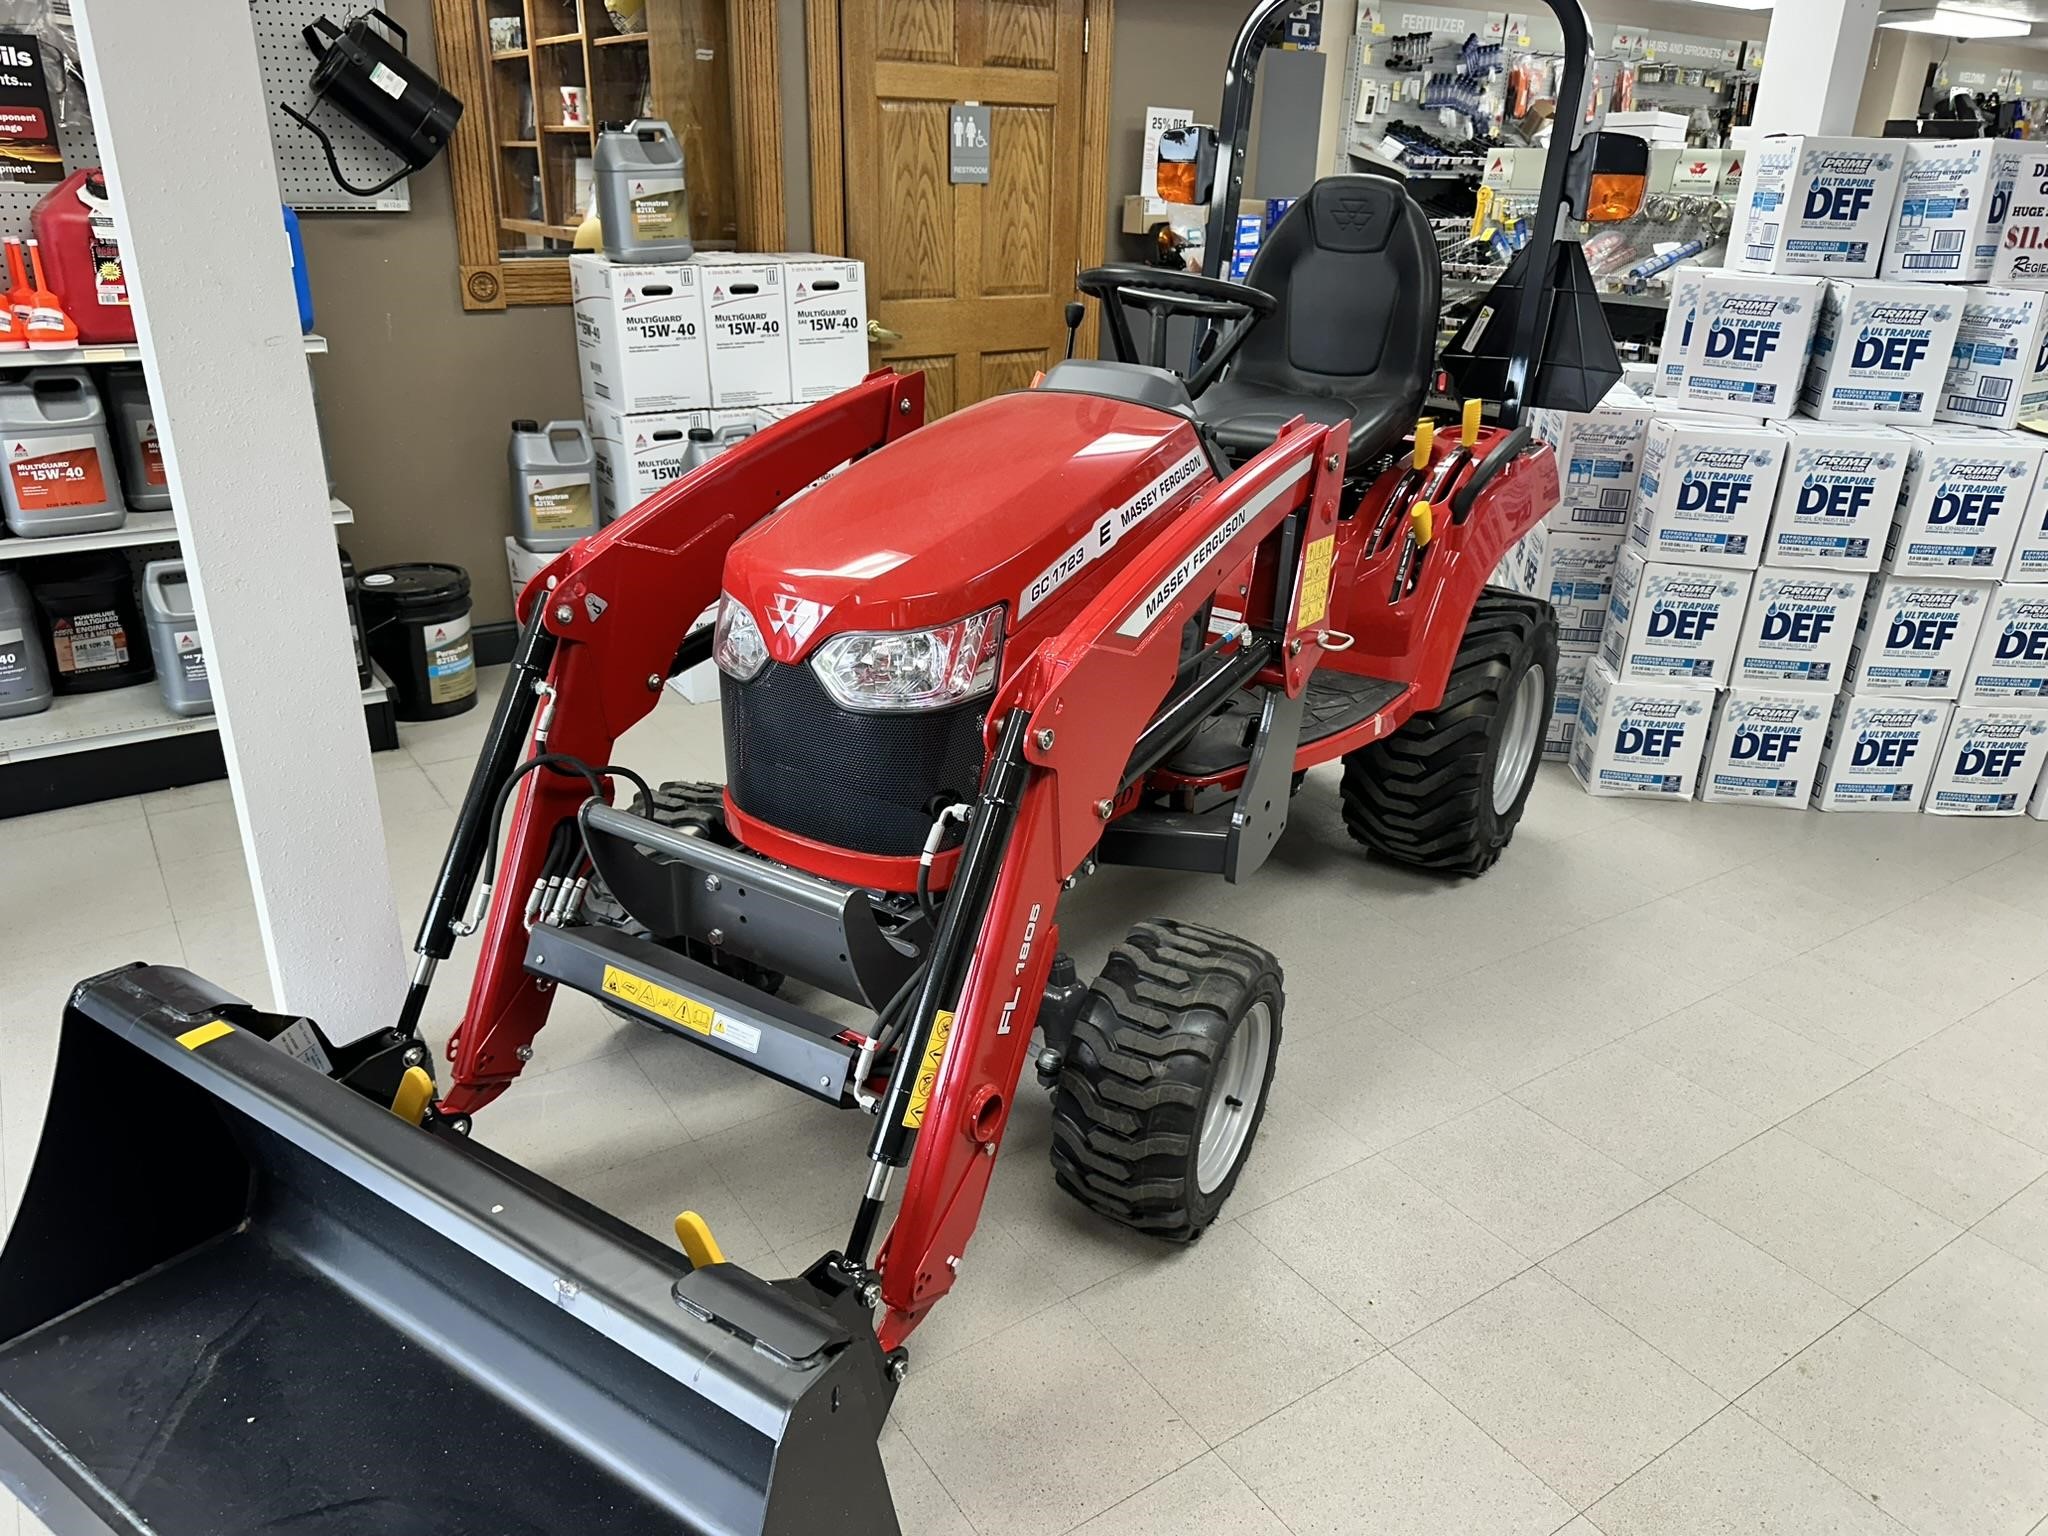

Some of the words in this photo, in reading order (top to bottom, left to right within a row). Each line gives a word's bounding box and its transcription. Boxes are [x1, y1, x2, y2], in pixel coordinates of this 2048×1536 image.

[1401, 13, 1465, 34] FERTILIZER
[1649, 39, 1668, 52] HUBS
[1669, 42, 1684, 54] AND
[1684, 44, 1722, 59] SPROCKETS
[0, 45, 33, 67] ils
[1151, 117, 1171, 130] 25%
[1824, 159, 1871, 167] PRIME
[953, 166, 988, 174] RESTROOM
[1821, 177, 1875, 187] ULTRAPURE
[1803, 189, 1873, 220] DEF
[2012, 206, 2045, 217] HUGE
[2010, 255, 2048, 273] REGIE
[1725, 301, 1777, 310] PRIME
[1874, 310, 1927, 318] PRIME
[727, 320, 779, 336] 15W-40
[809, 316, 858, 331] 15W-40
[1722, 318, 1782, 330] ULTRAPURE
[640, 323, 696, 338] 15W-40
[1870, 327, 1932, 338] ULTRAPURE
[1705, 328, 1780, 362] DEF
[1851, 338, 1929, 370] DEF
[637, 458, 681, 469] MULTIGUA
[1697, 454, 1748, 463] PRIME
[1710, 461, 1743, 469] GUARD
[1818, 458, 1871, 466] PRIME
[30, 467, 84, 481] 15W-40
[651, 467, 680, 480] 15W
[1694, 471, 1753, 482] ULTRAPURE
[1952, 466, 2004, 474] PRIME
[1815, 475, 1876, 485] ULTRAPURE
[1120, 490, 1158, 528] MASSEY
[1160, 456, 1202, 496] FERGUSON
[1948, 484, 2007, 494] ULTRAPURE
[1676, 481, 1751, 514] DEF
[1796, 485, 1874, 517] DEF
[1928, 495, 2004, 526] DEF
[1099, 519, 1111, 548] E
[1145, 566, 1190, 619] MASSEY
[1193, 509, 1247, 569] FERGUSON
[1031, 577, 1050, 602] GC
[1051, 548, 1085, 584] 1723
[1667, 584, 1716, 593] PRIME
[1781, 587, 1832, 595] PRIME
[1664, 600, 1720, 611] ULTRAPURE
[1778, 603, 1836, 613] ULTRAPURE
[1904, 611, 1960, 620] ULTRAPURE
[1647, 610, 1718, 640] DEF
[1761, 613, 1834, 643] DEF
[2016, 621, 2048, 632] ULTRA
[1885, 621, 1958, 650] DEF
[1995, 630, 2048, 660] DE
[1632, 704, 1680, 712] PRIME
[1750, 709, 1798, 717] PRIME
[1630, 719, 1685, 729] ULTRAPURE
[1747, 724, 1803, 734] ULTRAPURE
[1977, 725, 2025, 733] PRIME
[1615, 728, 1684, 757] DEF
[1730, 733, 1801, 762] DEF
[1973, 741, 2028, 749] ULTRAPURE
[1851, 740, 1919, 766] DEF
[1955, 750, 2026, 776] DEF
[997, 986, 1021, 1035] FL
